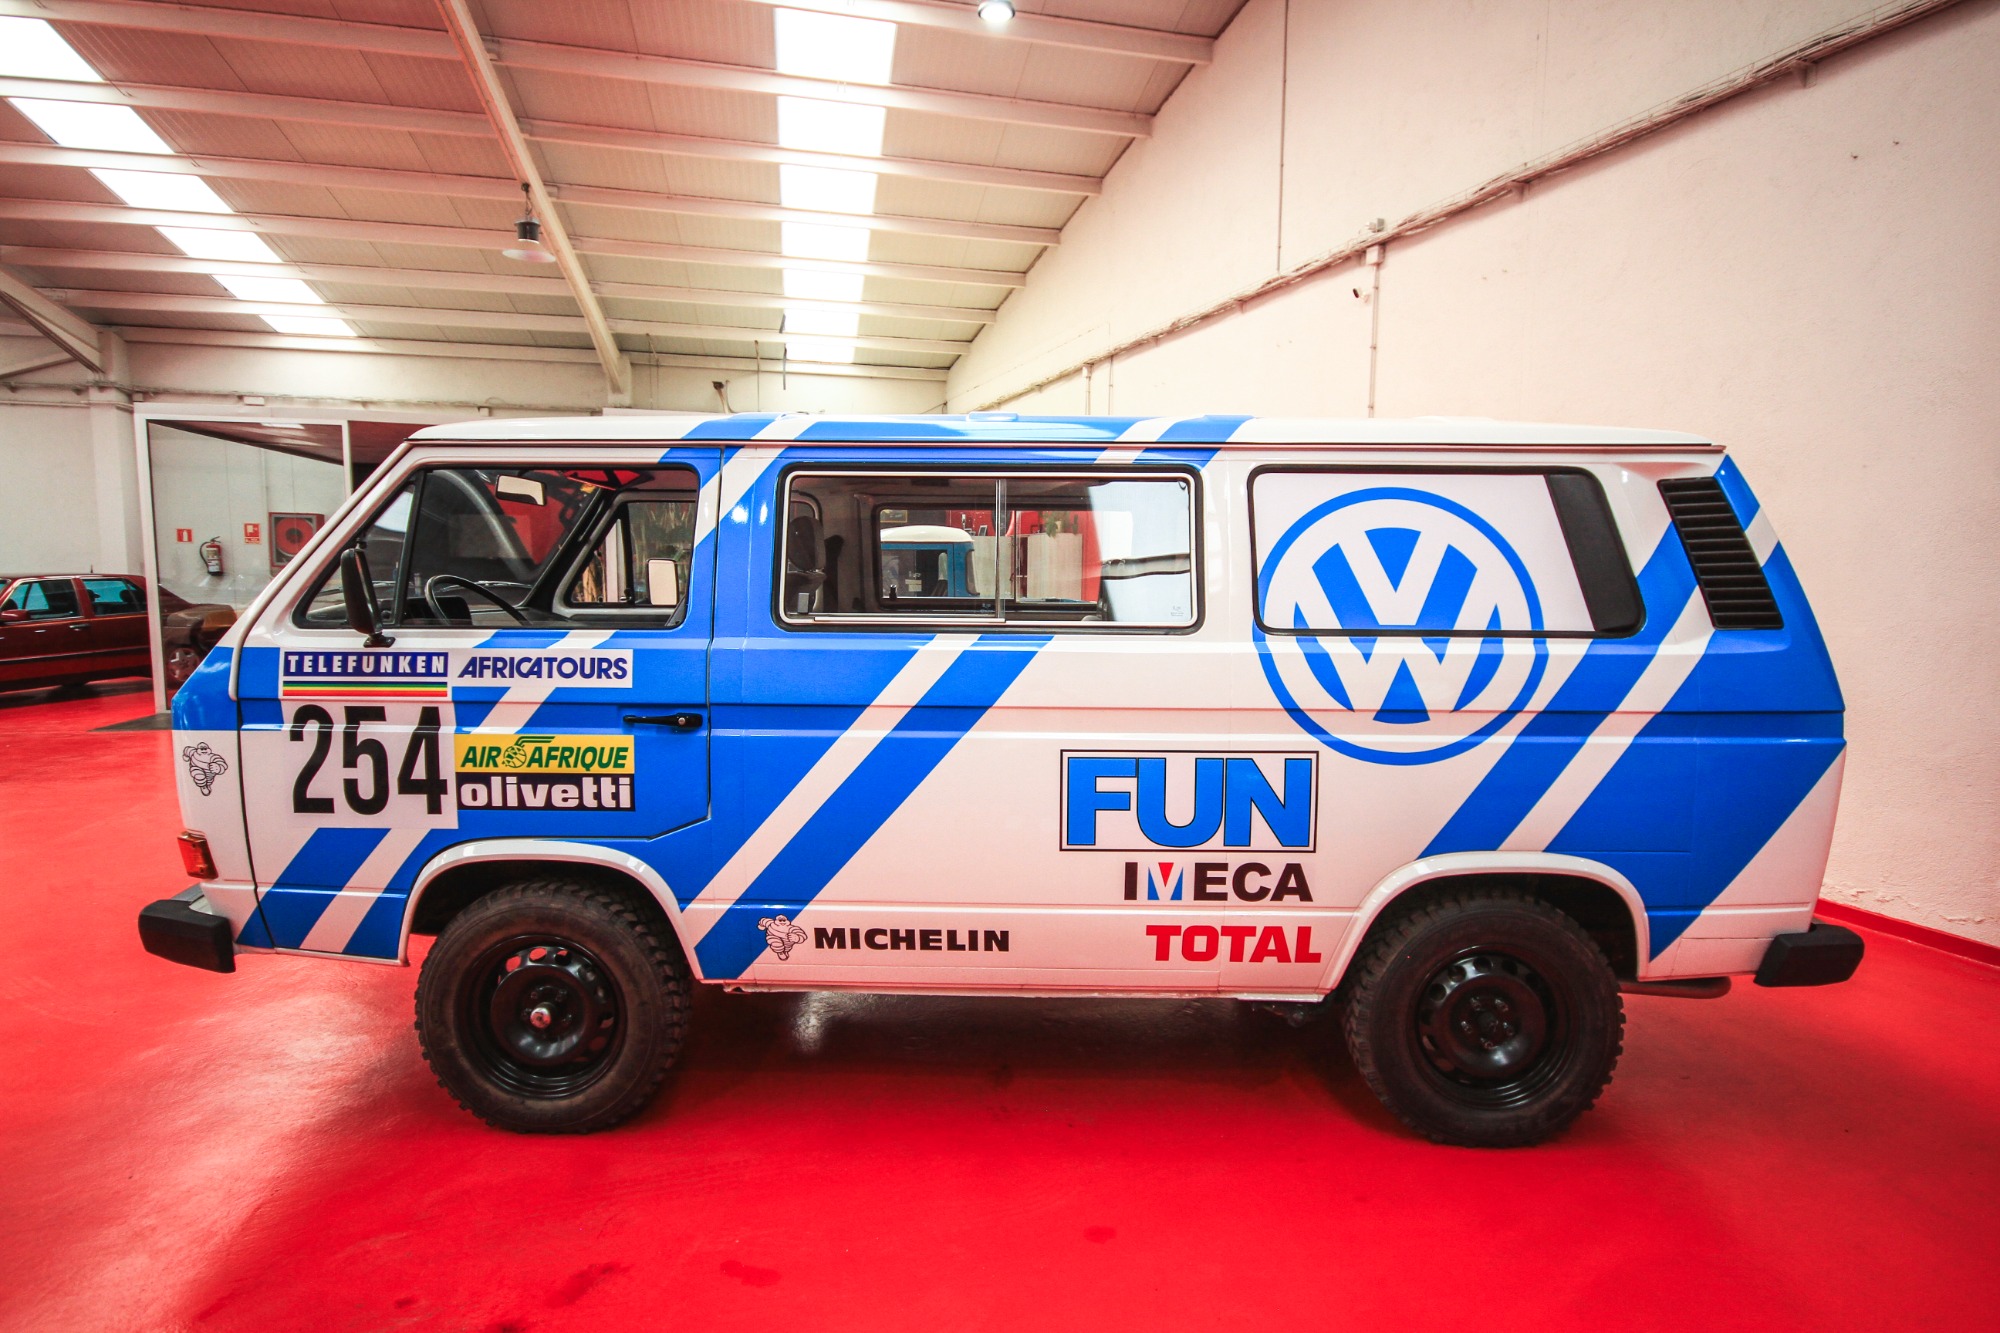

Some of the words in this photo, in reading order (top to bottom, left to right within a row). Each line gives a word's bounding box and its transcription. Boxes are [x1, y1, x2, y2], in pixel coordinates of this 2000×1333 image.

[287, 655, 445, 674] TELEFUNKEN
[458, 656, 628, 679] AFRICATOURS
[289, 704, 448, 815] 254
[460, 746, 502, 768] AIR
[525, 746, 629, 771] AFRIQUE
[460, 775, 632, 809] olivetti
[1066, 757, 1312, 848] FUN
[814, 927, 1010, 952] MICHELIN
[1146, 925, 1321, 963] TOTAL
